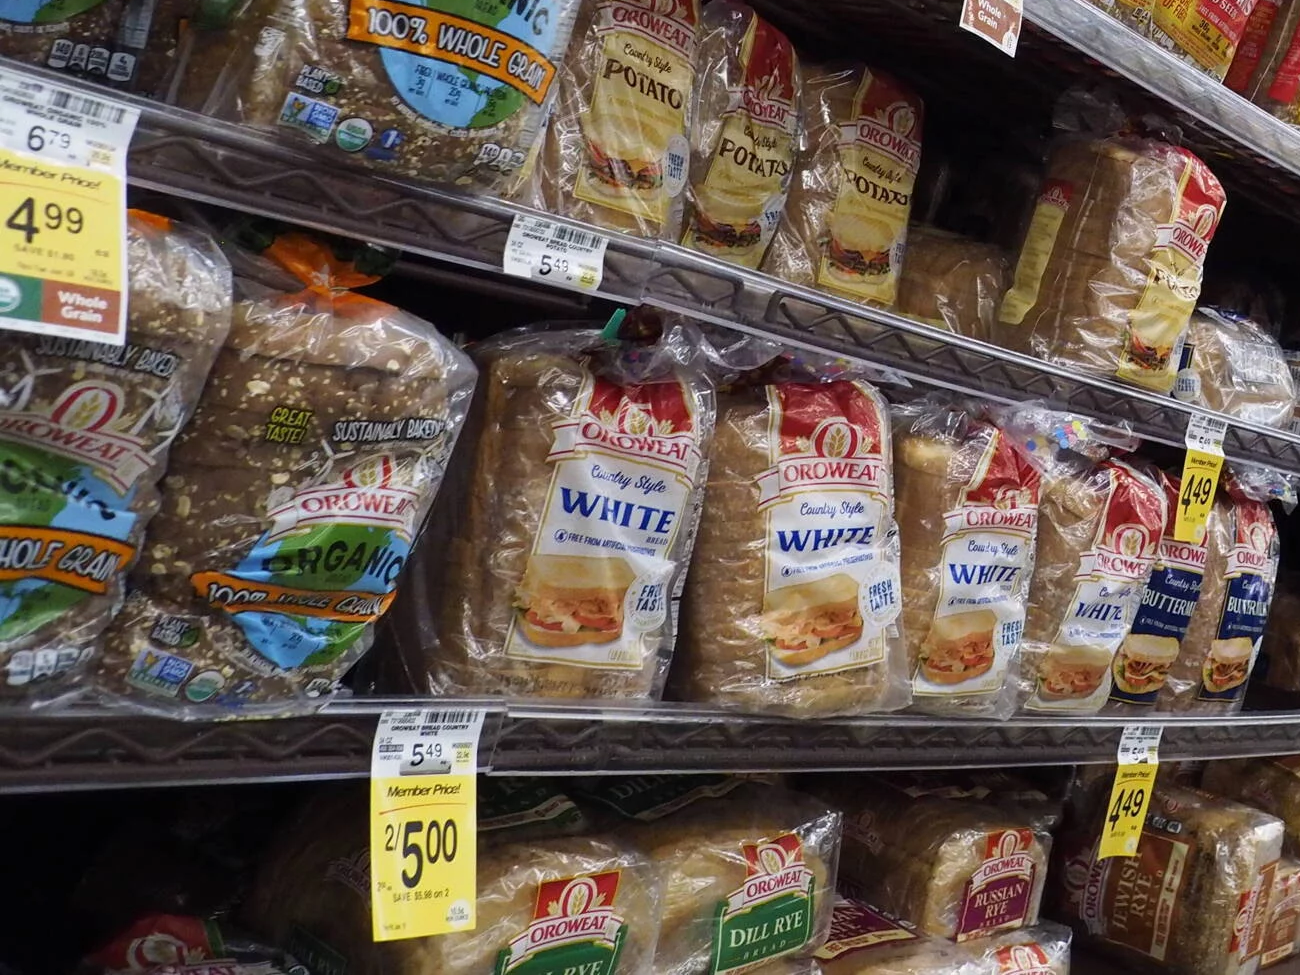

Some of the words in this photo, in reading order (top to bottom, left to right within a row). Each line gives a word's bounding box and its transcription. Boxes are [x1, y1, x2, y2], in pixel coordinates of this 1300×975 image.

[612, 5, 691, 47] OROWEAT
[978, 9, 998, 30] Grain
[367, 7, 429, 46] 100%
[437, 22, 507, 70] WHOLE
[507, 51, 548, 92] GRAIN
[623, 41, 652, 68] Country
[653, 54, 673, 74] Style
[602, 58, 683, 111] POTATO
[668, 151, 685, 169] FRESH
[61, 171, 103, 191] Price!
[666, 164, 684, 182] TASTE
[58, 289, 109, 310] Whole
[61, 305, 103, 324] Grain
[270, 406, 313, 427] GREAT
[265, 423, 307, 444] TASTE!
[581, 422, 688, 463] OROWEAT
[591, 463, 632, 494] Country
[635, 474, 668, 494] Style
[783, 462, 880, 483] OROWEAT
[560, 486, 676, 536] WHITE
[799, 501, 838, 518] Country
[840, 501, 865, 516] Style
[966, 508, 1037, 529] OROWEAT
[777, 526, 875, 553] WHITE
[949, 563, 1021, 586] WHITE
[868, 580, 894, 600] FRESH
[869, 591, 896, 613] TASTE
[387, 784, 433, 799] Member
[432, 782, 461, 796] Price!
[983, 856, 1026, 877] OROWEAT
[746, 871, 802, 898] OROWEAT
[392, 891, 411, 903] SAVE
[974, 883, 1025, 908] RUSSIAN
[984, 901, 1009, 920] RYE
[531, 915, 607, 944] OROWEAT
[728, 926, 771, 951] DILL
[772, 910, 804, 937] RYE
